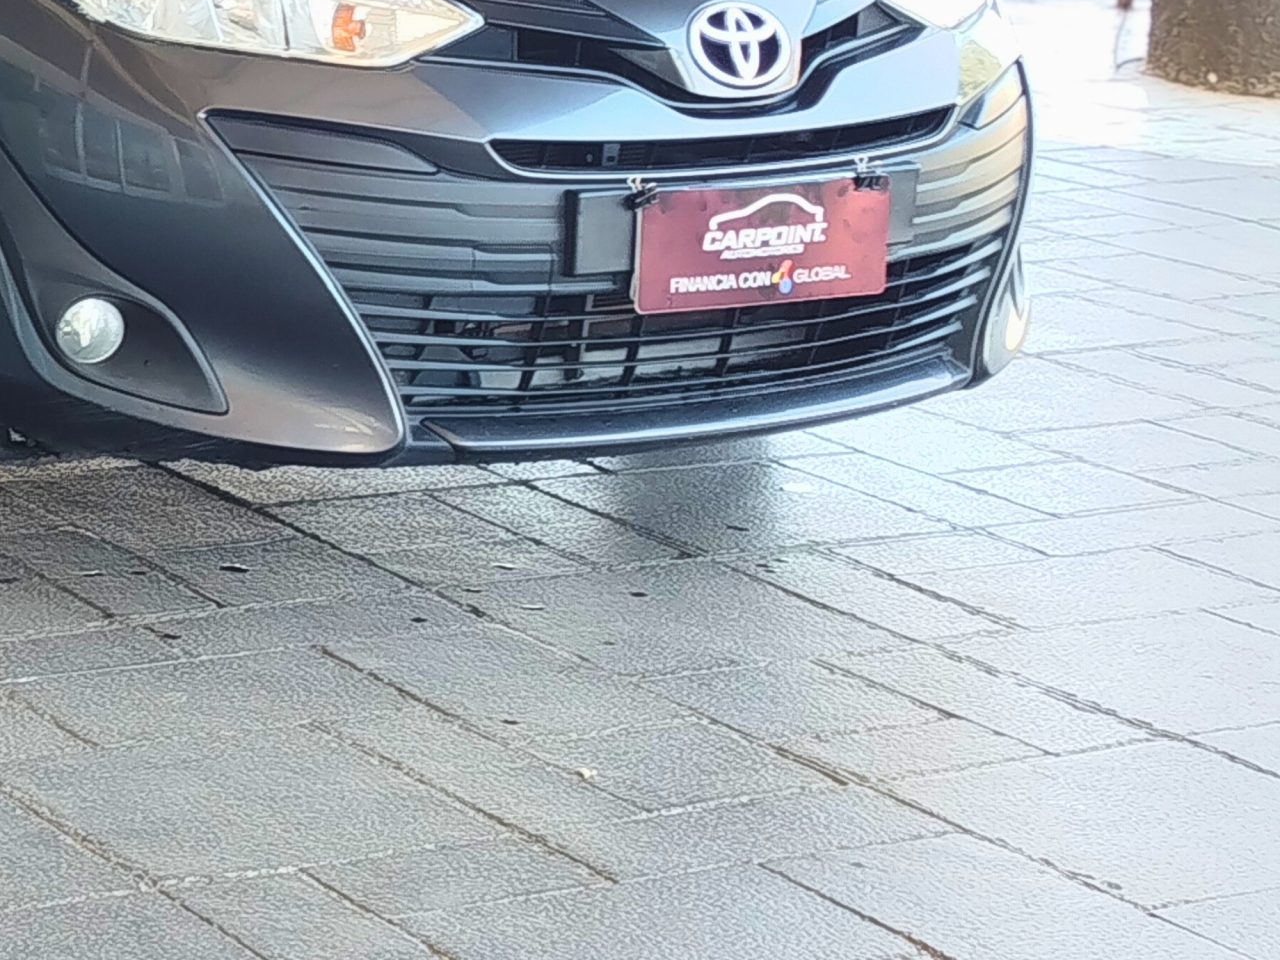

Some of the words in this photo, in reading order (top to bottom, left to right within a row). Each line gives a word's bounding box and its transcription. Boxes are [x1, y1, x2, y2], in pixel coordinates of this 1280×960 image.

[702, 222, 828, 252] CARPOINT
[670, 273, 737, 293] FINANCIA
[738, 271, 772, 289] CON
[793, 265, 851, 284] GLOBAL
